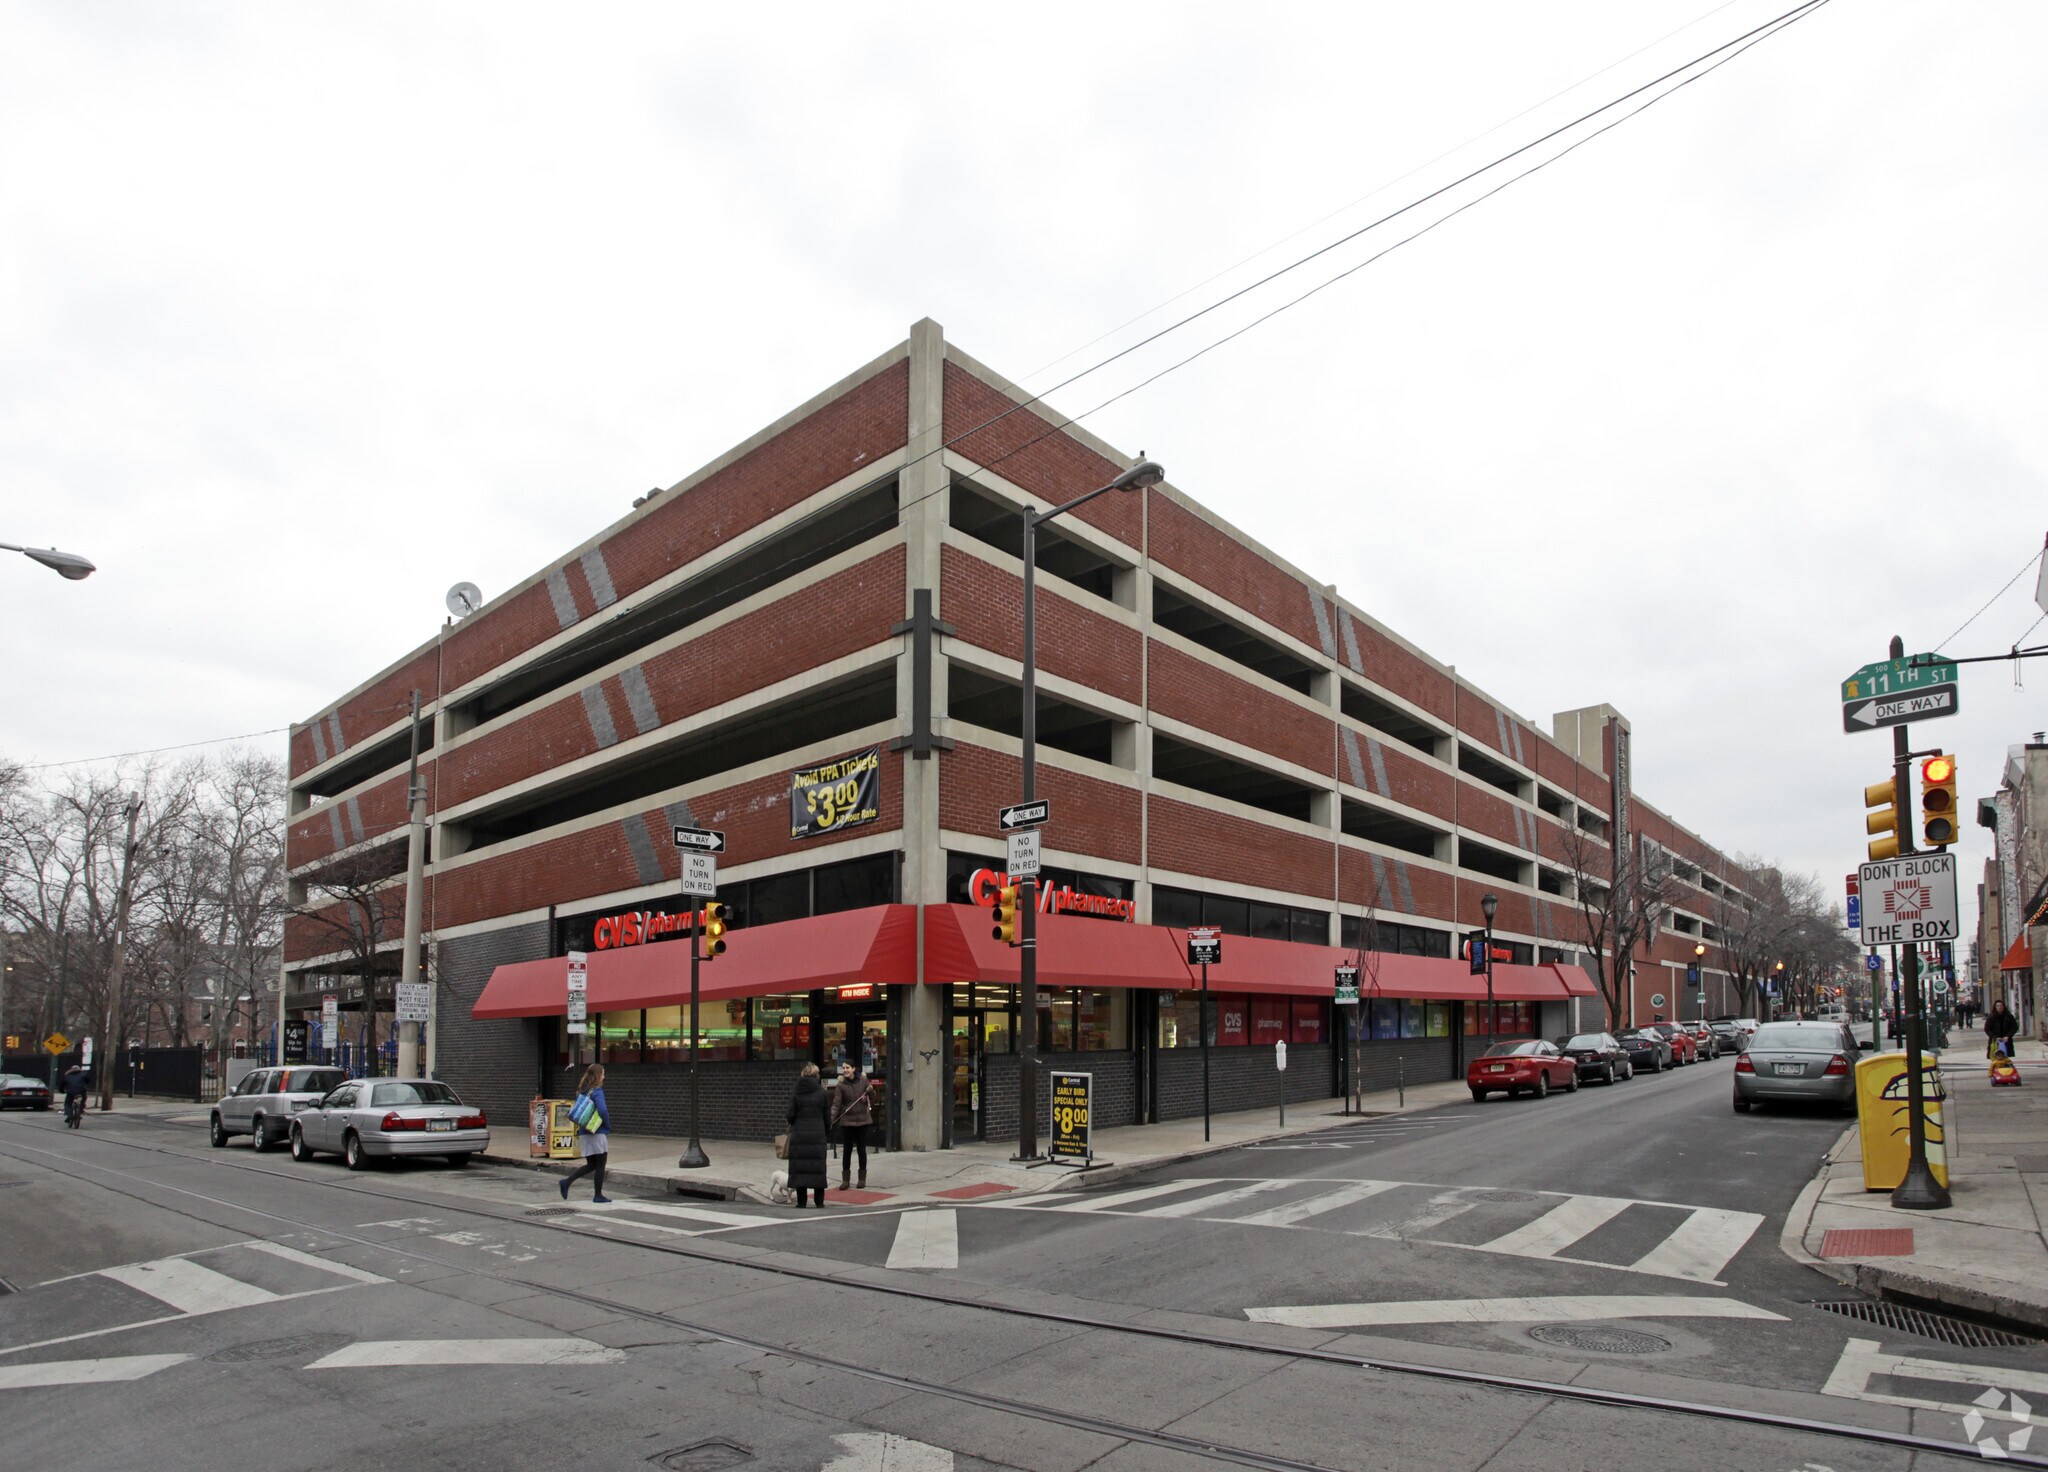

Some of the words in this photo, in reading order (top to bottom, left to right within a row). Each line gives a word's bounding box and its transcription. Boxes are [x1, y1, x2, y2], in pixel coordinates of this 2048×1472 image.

[1875, 664, 1889, 673] 500
[1894, 660, 1900, 671] S
[1866, 673, 1889, 695] 11
[1896, 668, 1919, 684] TH
[1931, 668, 1948, 683] ST
[1876, 702, 1906, 718] ONE
[1910, 694, 1944, 711] WAY
[793, 768, 819, 790] Avoid
[820, 764, 839, 783] PPA
[839, 753, 878, 777] Tickets
[861, 808, 877, 819] Rate
[1013, 810, 1027, 821] ONE
[1028, 807, 1043, 818] WAY
[679, 833, 693, 843] ONE
[695, 835, 710, 844] WAY
[1017, 836, 1030, 846] NO
[1014, 848, 1034, 859] TURN
[692, 858, 705, 868] NO
[1010, 862, 1020, 872] ON
[1022, 859, 1037, 870] RED
[1905, 857, 1950, 877] BLOCK
[689, 869, 709, 879] TURN
[684, 880, 695, 889] ON
[697, 881, 713, 891] RED
[1867, 924, 1903, 942] THE
[1912, 919, 1951, 939] BOX
[568, 993, 574, 1001] 2
[841, 990, 853, 998] ATM
[852, 988, 870, 997] INSIDE
[1224, 1012, 1242, 1027] CVS
[1257, 1017, 1284, 1030] pharmacy
[1299, 1018, 1321, 1029] beverage
[1056, 1086, 1073, 1095] EARLY
[1073, 1087, 1086, 1096] BIRD
[1053, 1096, 1074, 1106] SPECIAL
[1074, 1097, 1088, 1106] ONLY
[554, 1136, 573, 1148] PW
